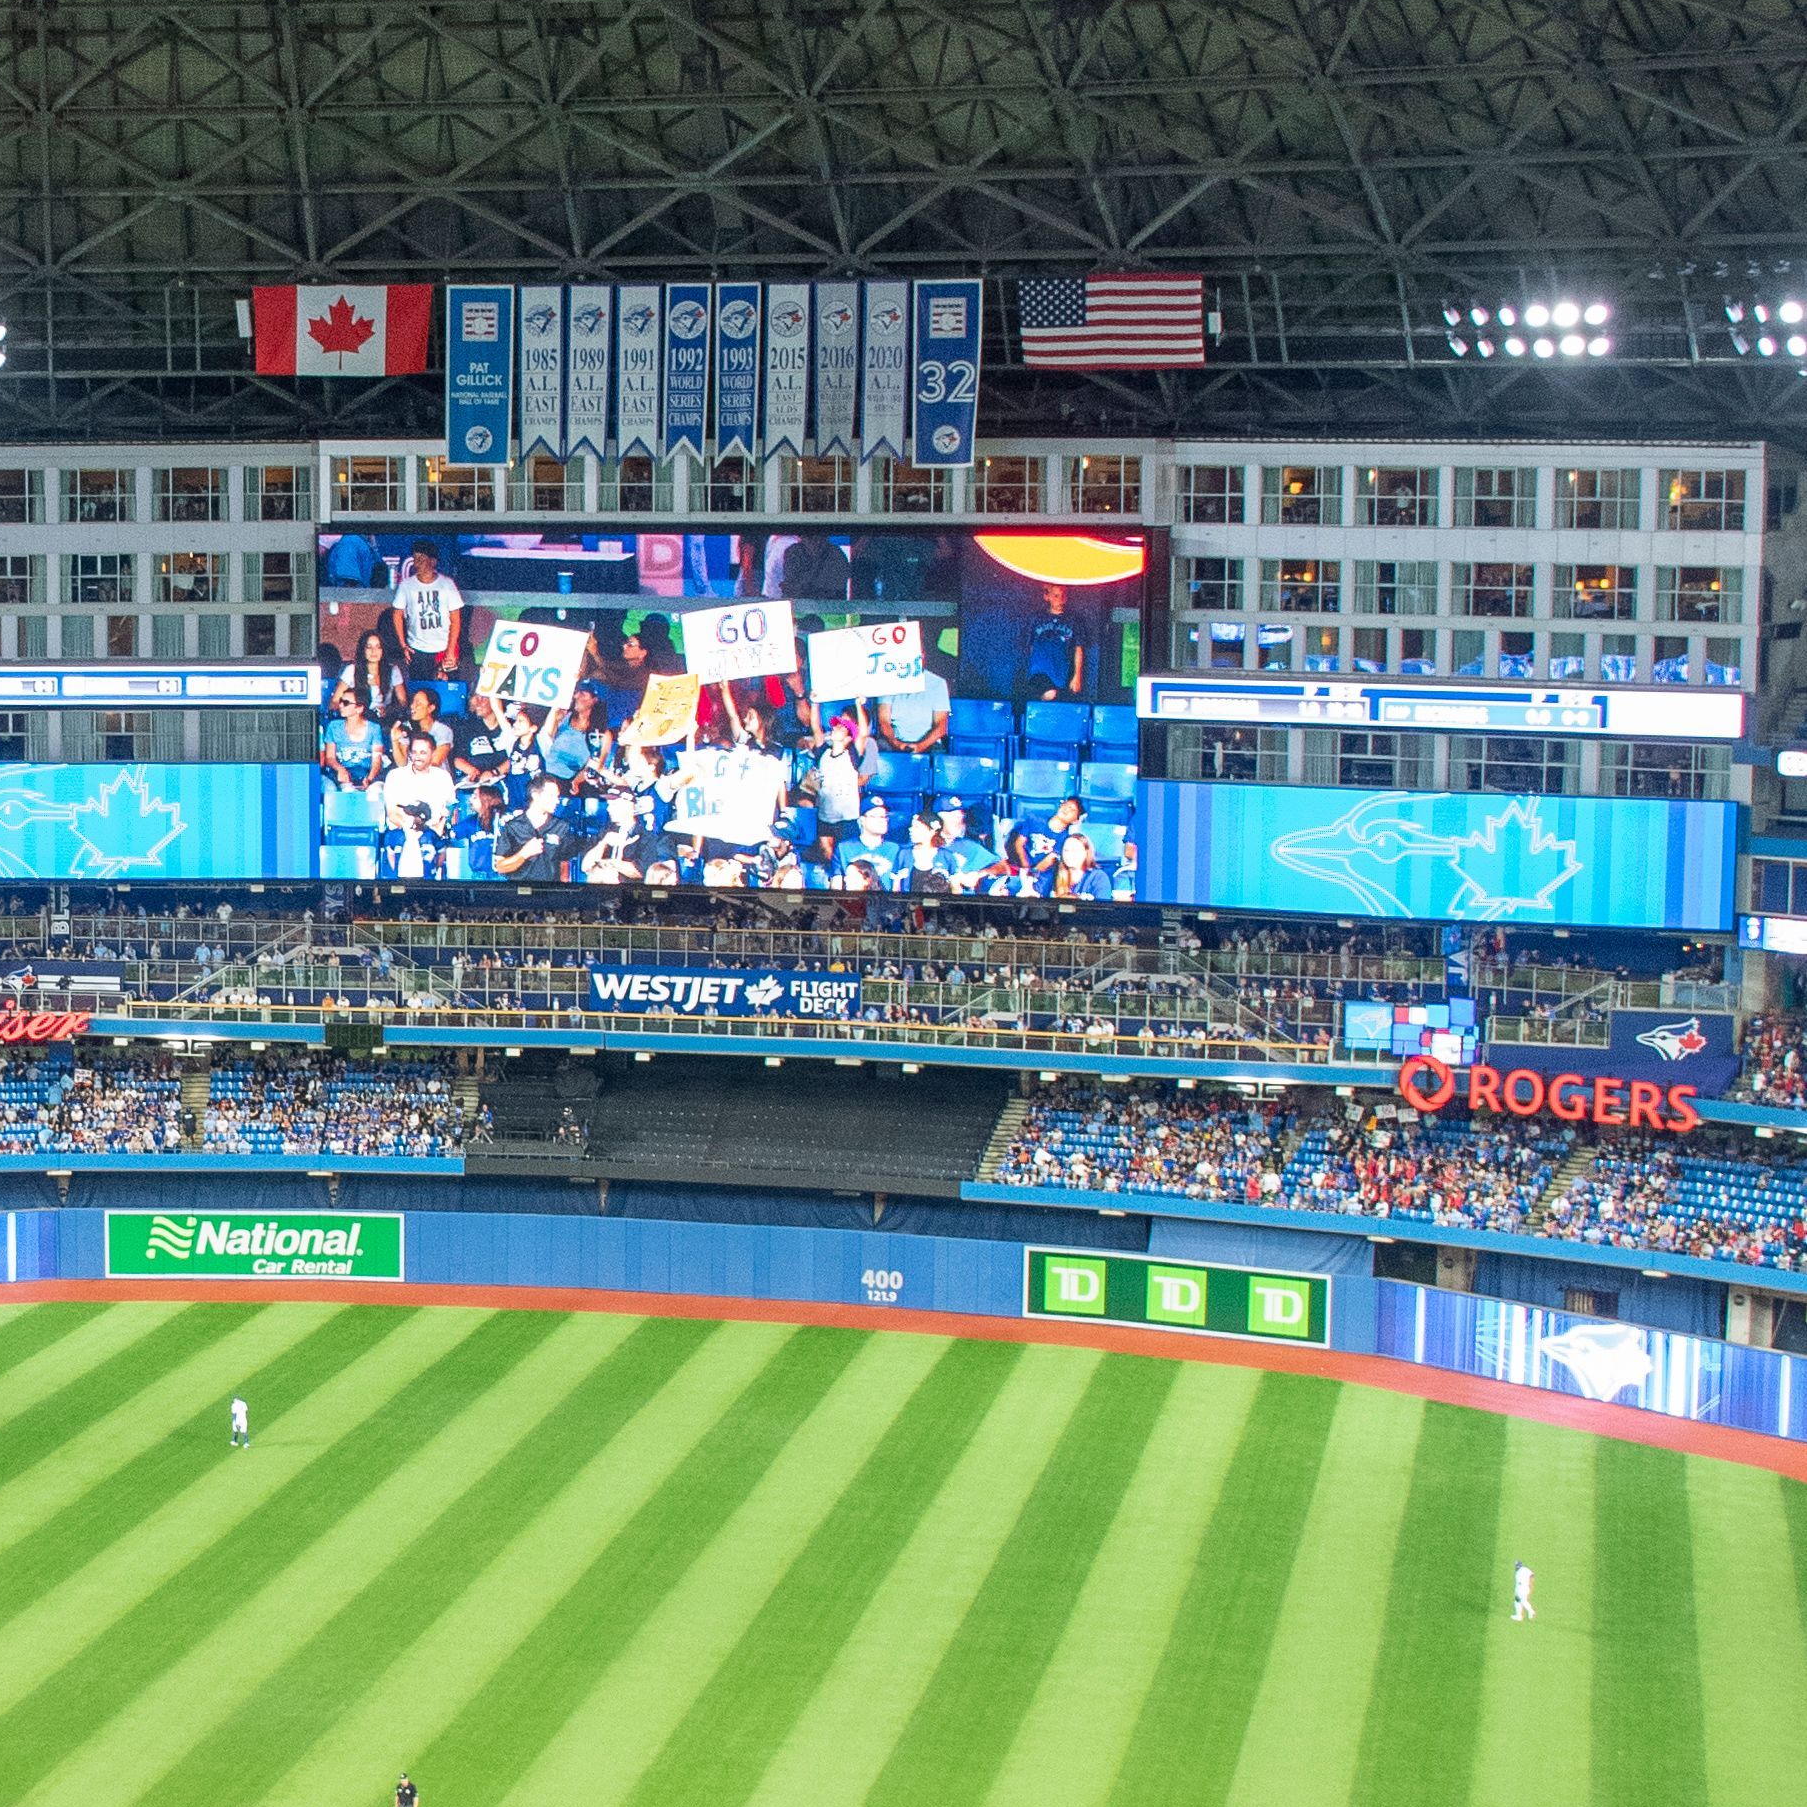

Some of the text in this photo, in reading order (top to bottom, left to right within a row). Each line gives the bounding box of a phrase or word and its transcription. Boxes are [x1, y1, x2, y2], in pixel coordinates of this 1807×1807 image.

[525, 348, 557, 371] 1985
[573, 348, 605, 370] 1989
[624, 348, 654, 371] 1991
[671, 347, 704, 371] 1992
[722, 347, 754, 371] 1993
[770, 346, 805, 370] 2015
[820, 346, 854, 369] 2016
[868, 345, 903, 369] 2020
[469, 362, 490, 374] PAT
[456, 374, 503, 386] GILLICK
[527, 375, 557, 392] A.L.
[574, 376, 604, 391] A.L.
[624, 376, 655, 391] A.L.
[670, 376, 703, 390] WORLD
[721, 375, 753, 390] WORLD
[772, 375, 802, 390] A.L.
[823, 374, 852, 389] A.L.
[871, 374, 900, 389] A.L.
[918, 359, 977, 404] 32
[525, 396, 557, 412] EAST
[571, 396, 604, 412] EAST
[623, 396, 655, 413] EAST
[669, 394, 702, 408] SERIES
[721, 394, 752, 408] SERIES
[668, 412, 702, 426] CHAMPS
[720, 412, 752, 426] CHAMPS
[715, 607, 767, 644] GO
[496, 628, 539, 657] GO
[872, 626, 907, 645] GO
[867, 651, 923, 679] Jays
[481, 664, 562, 702] JAYS
[591, 971, 745, 1011] WESTJET
[790, 979, 859, 999] FLIGHT
[799, 996, 850, 1015] DECK
[1469, 1064, 1699, 1132] ROGERS
[252, 1258, 353, 1275] Car Rental
[861, 1269, 904, 1290] 400
[1049, 1264, 1100, 1303] TD
[1152, 1276, 1201, 1314] TD
[1256, 1286, 1304, 1325] TD
